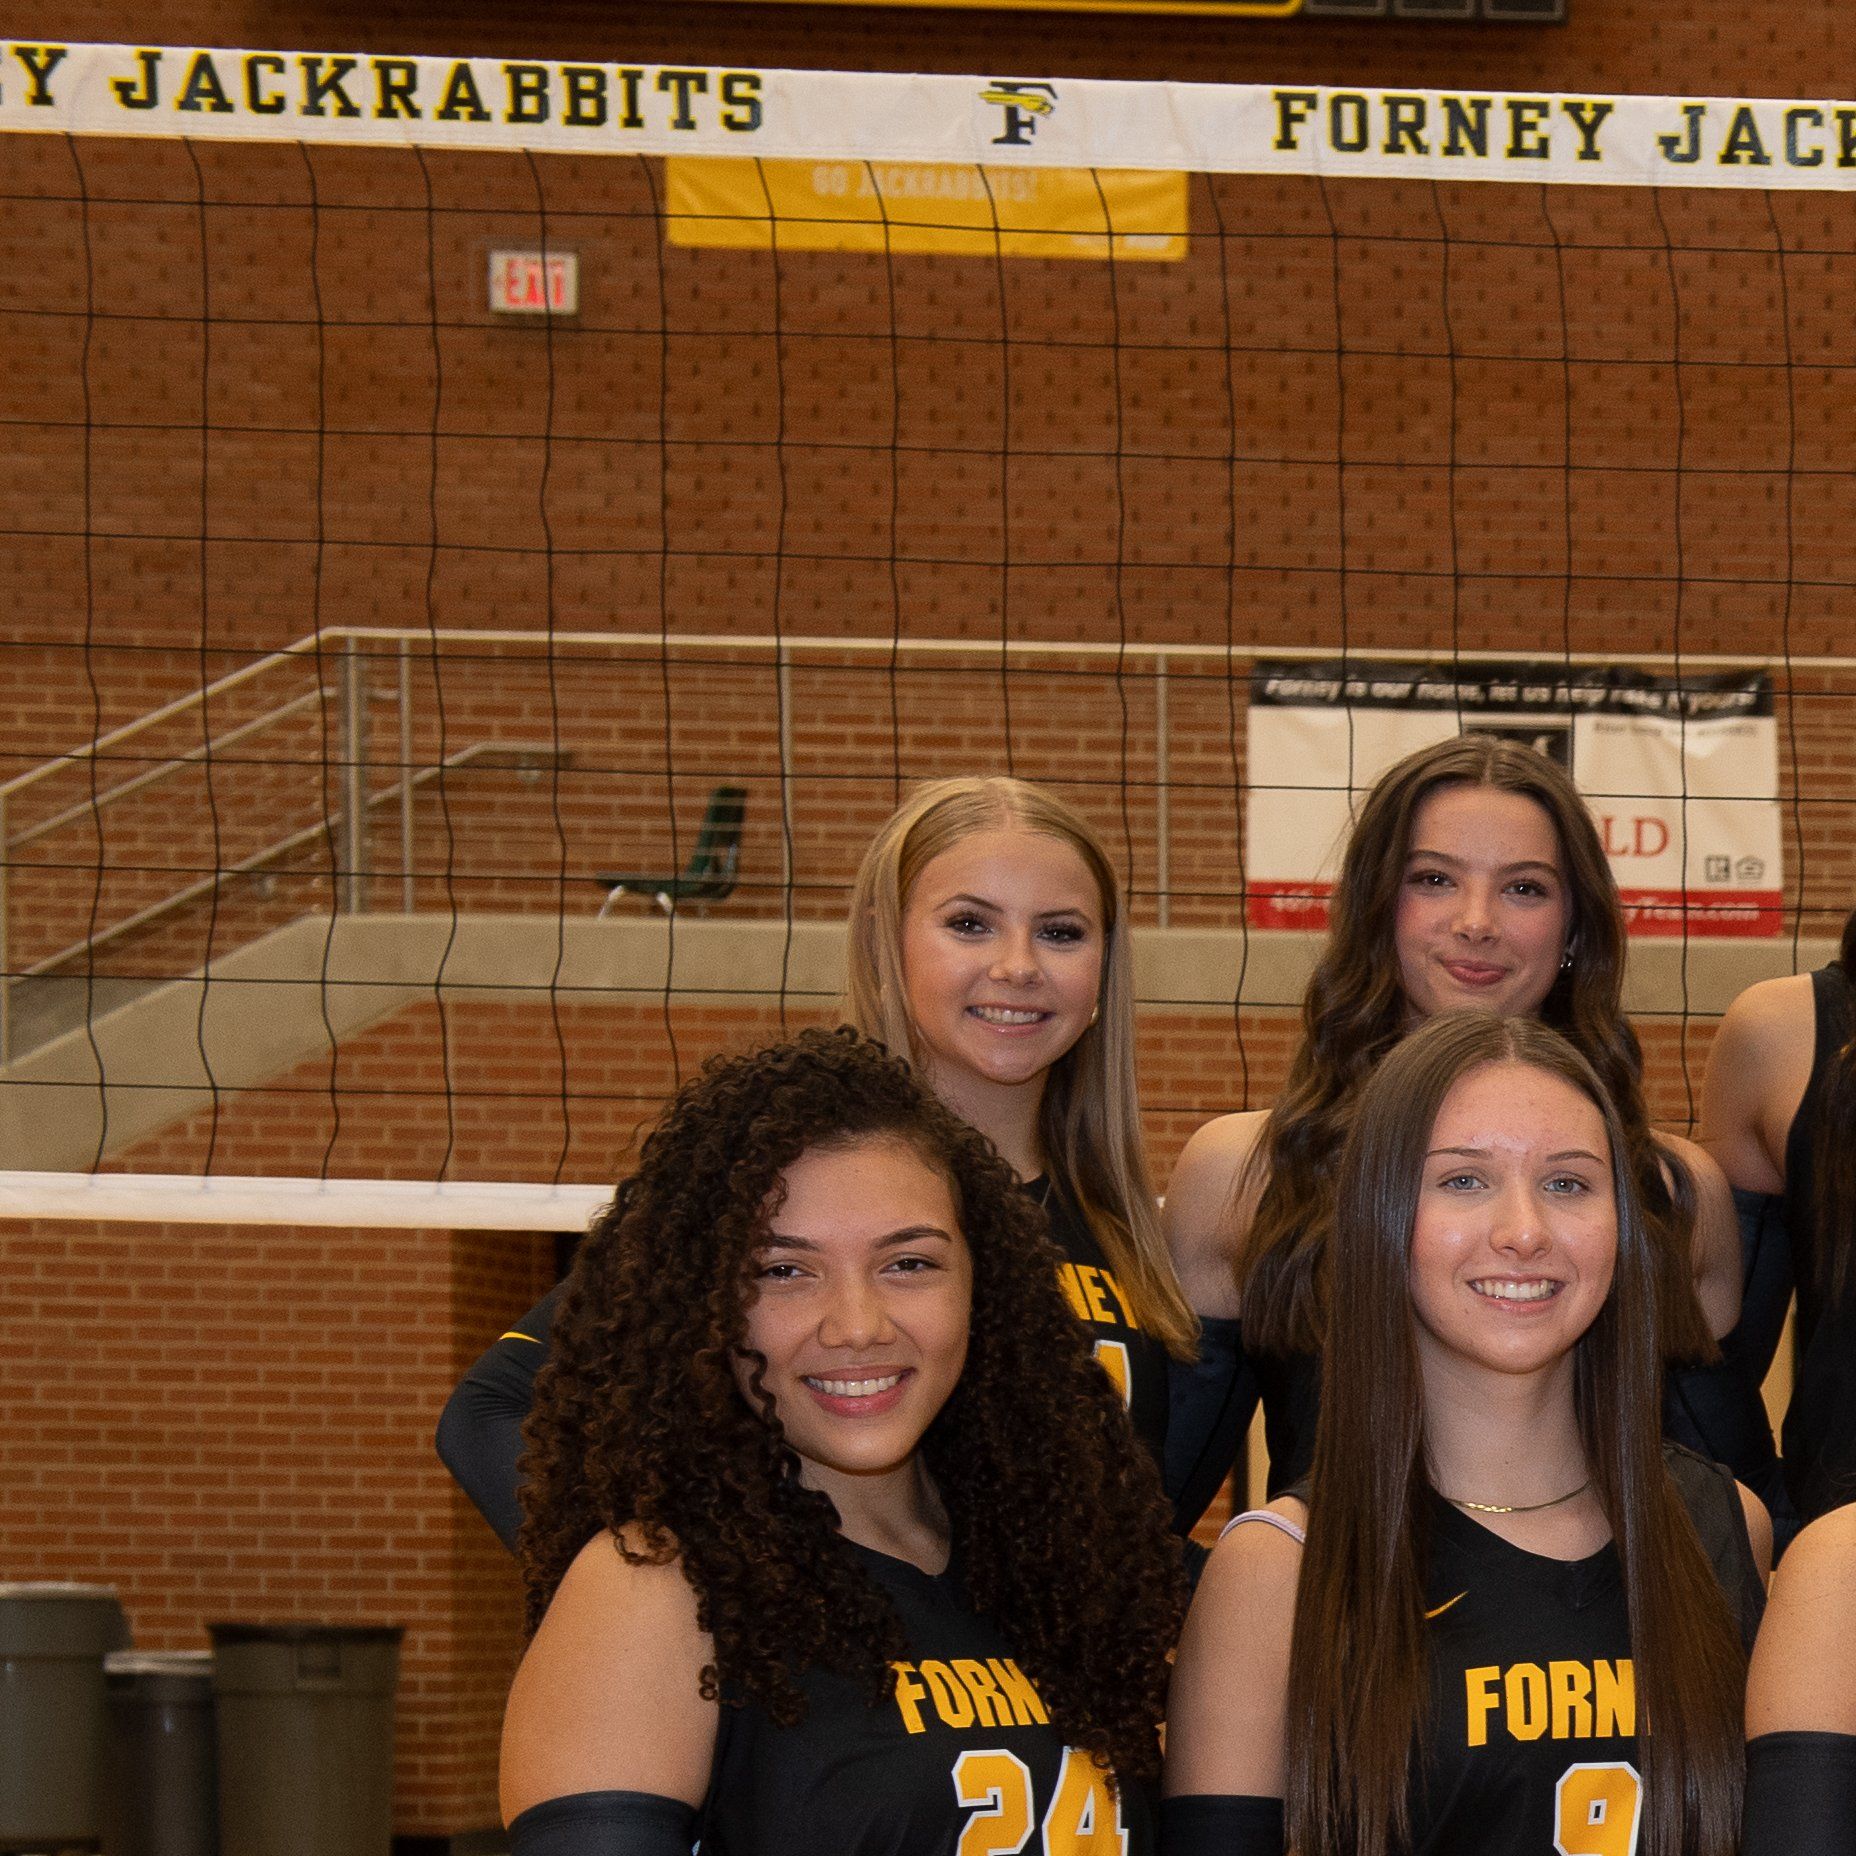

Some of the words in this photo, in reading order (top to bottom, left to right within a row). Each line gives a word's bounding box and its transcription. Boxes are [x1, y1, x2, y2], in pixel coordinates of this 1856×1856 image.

[110, 49, 763, 132] JACKRABBITS
[1270, 90, 1614, 161] FORNEY
[895, 1658, 1050, 1734] FORN
[1464, 1659, 1638, 1747] FORN
